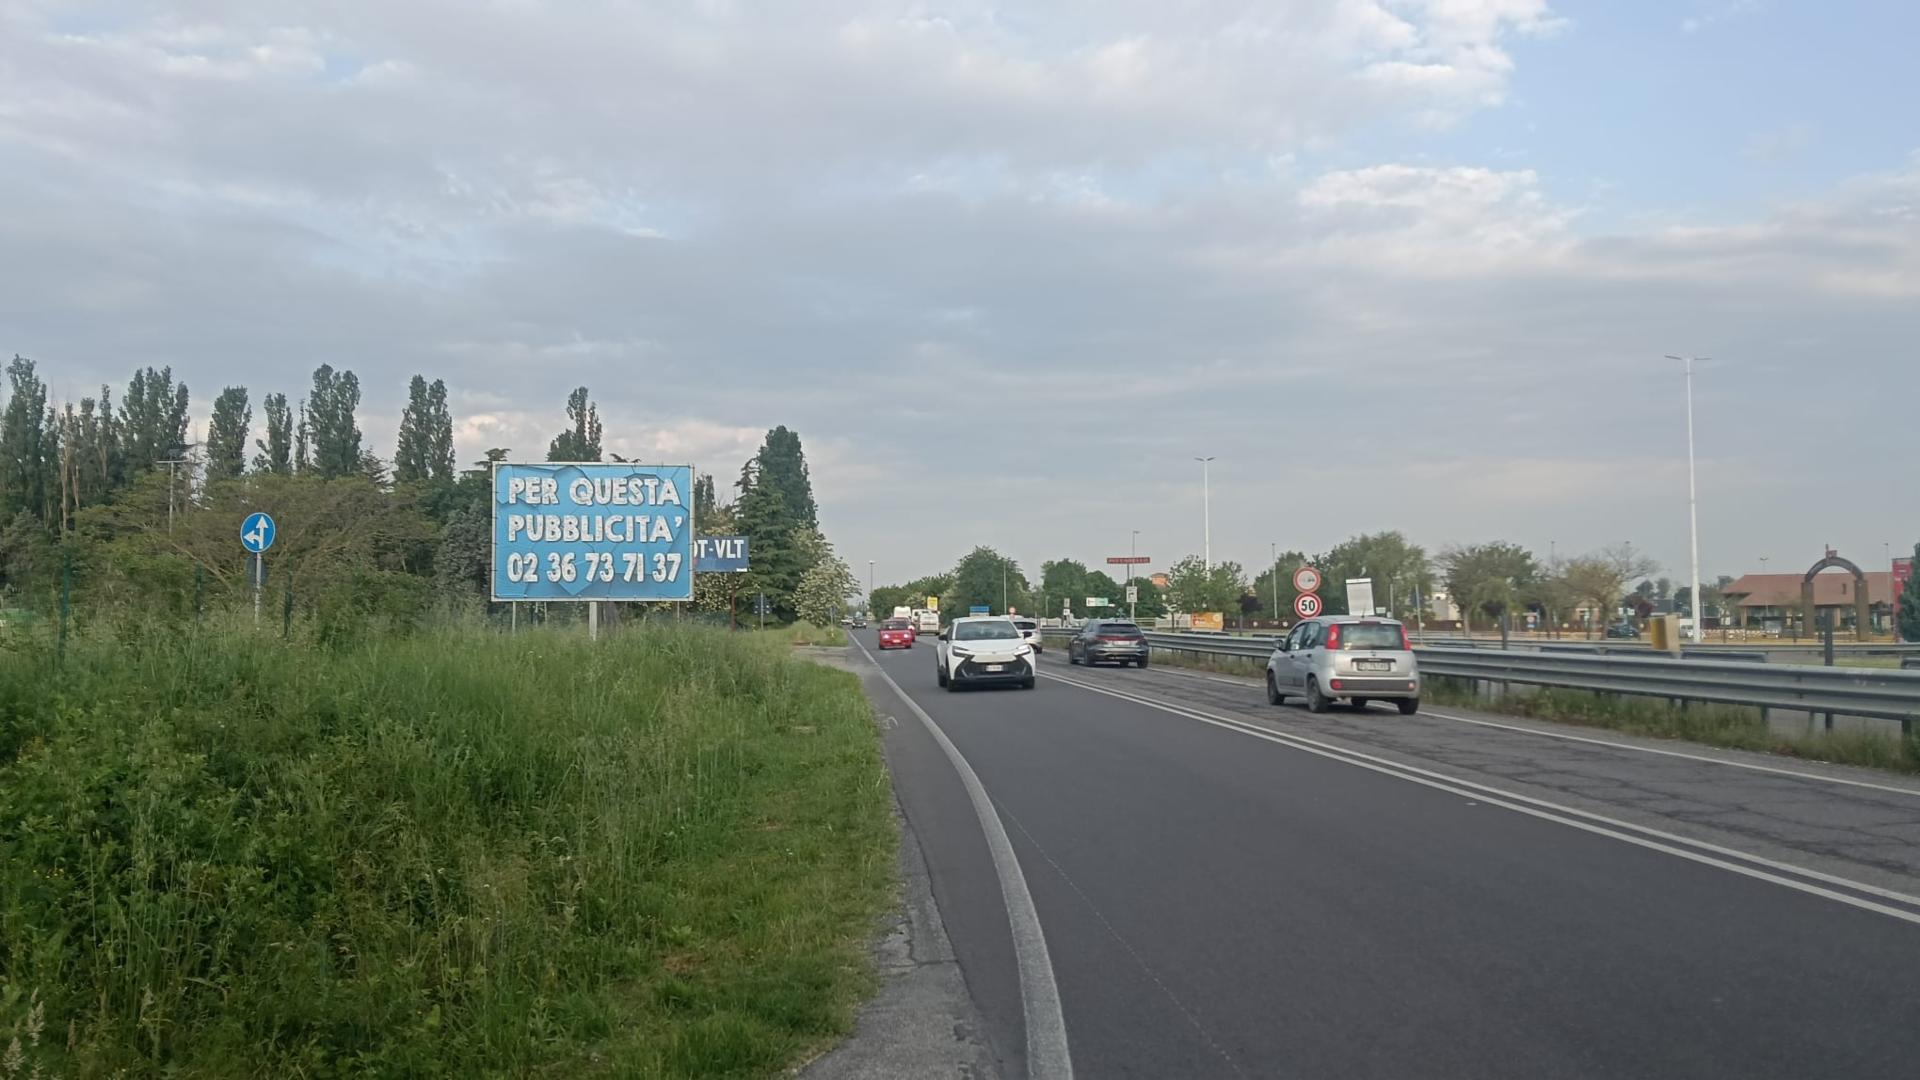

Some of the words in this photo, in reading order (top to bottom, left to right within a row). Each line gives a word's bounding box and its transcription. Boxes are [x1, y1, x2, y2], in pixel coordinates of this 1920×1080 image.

[508, 477, 559, 505] PER
[569, 477, 681, 506] QUESTA
[507, 552, 539, 583] 02
[547, 552, 577, 583] 36
[585, 552, 614, 583] 73
[622, 552, 645, 583] 71
[652, 552, 682, 583] 37
[1301, 599, 1316, 612] 50
